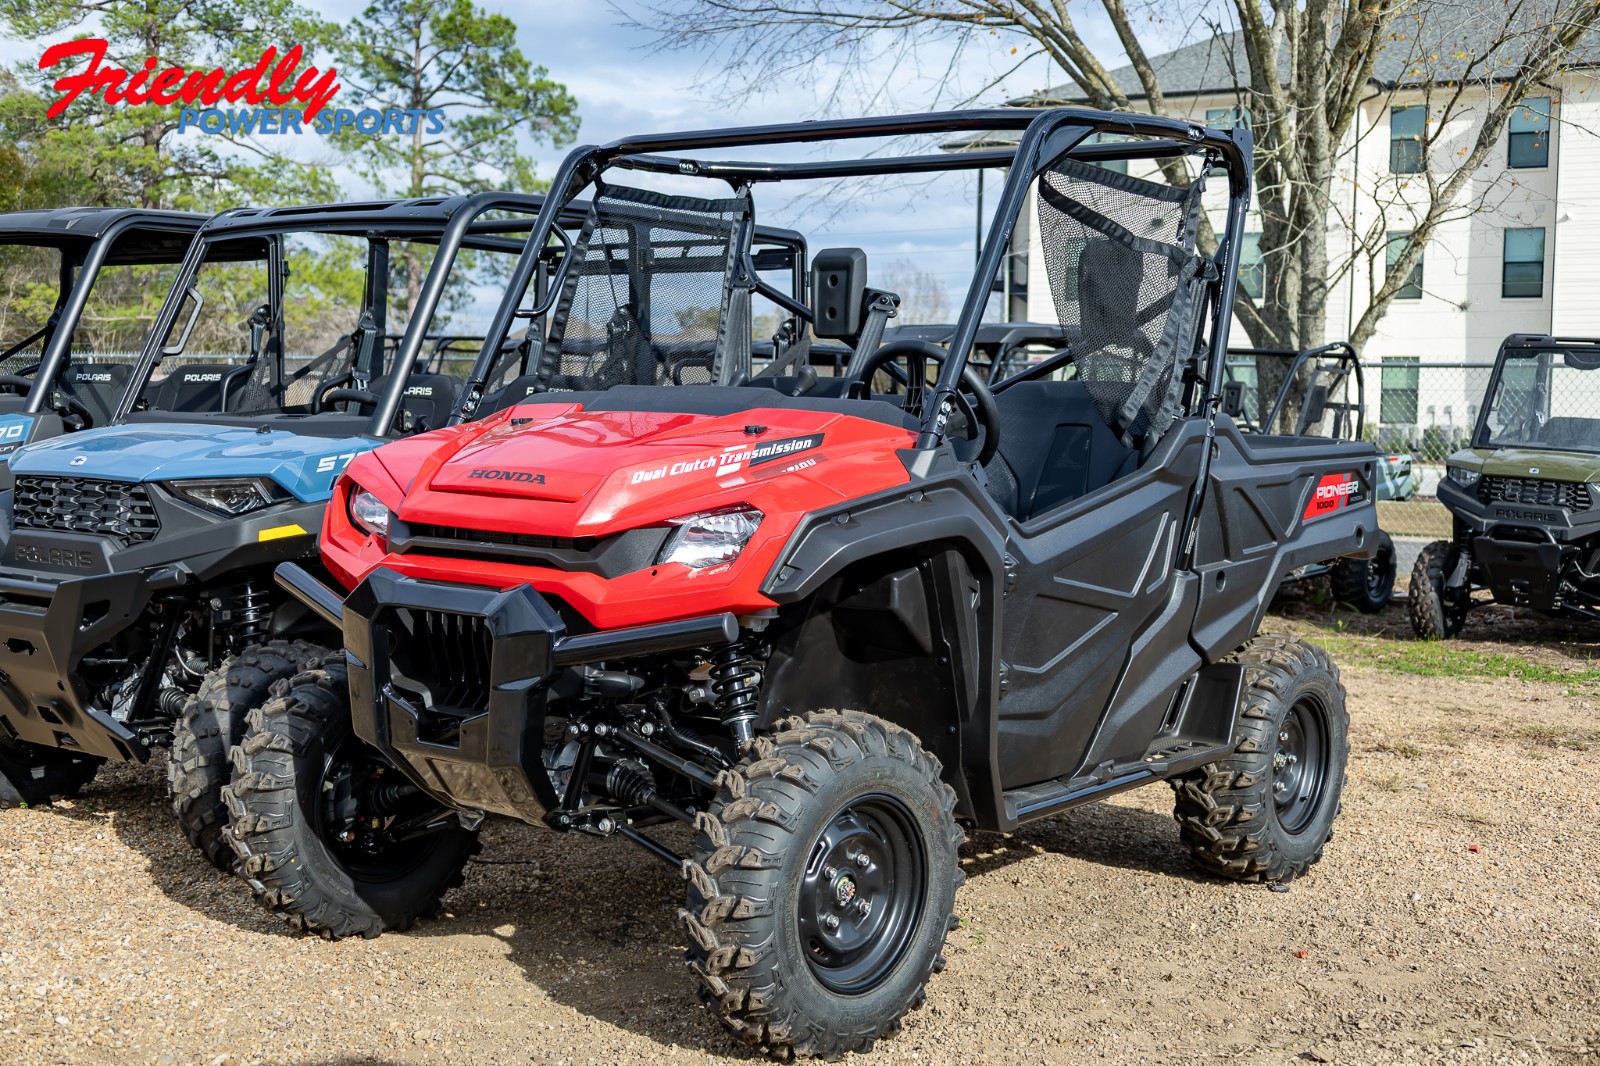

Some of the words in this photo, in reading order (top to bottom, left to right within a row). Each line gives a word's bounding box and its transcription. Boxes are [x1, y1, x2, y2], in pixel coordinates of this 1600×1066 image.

[76, 373, 111, 382] POLARIS
[184, 373, 221, 382] POLARIS
[403, 386, 433, 396] LARIS
[316, 450, 373, 473] 57
[630, 465, 668, 485] Dual
[669, 455, 717, 476] Clutch
[719, 438, 812, 467] Transmission
[467, 469, 546, 485] HONDA
[1316, 480, 1359, 500] PIONEER
[1316, 500, 1334, 510] 1000
[1495, 508, 1557, 522] POLARIS
[15, 543, 93, 568] POLARIS
